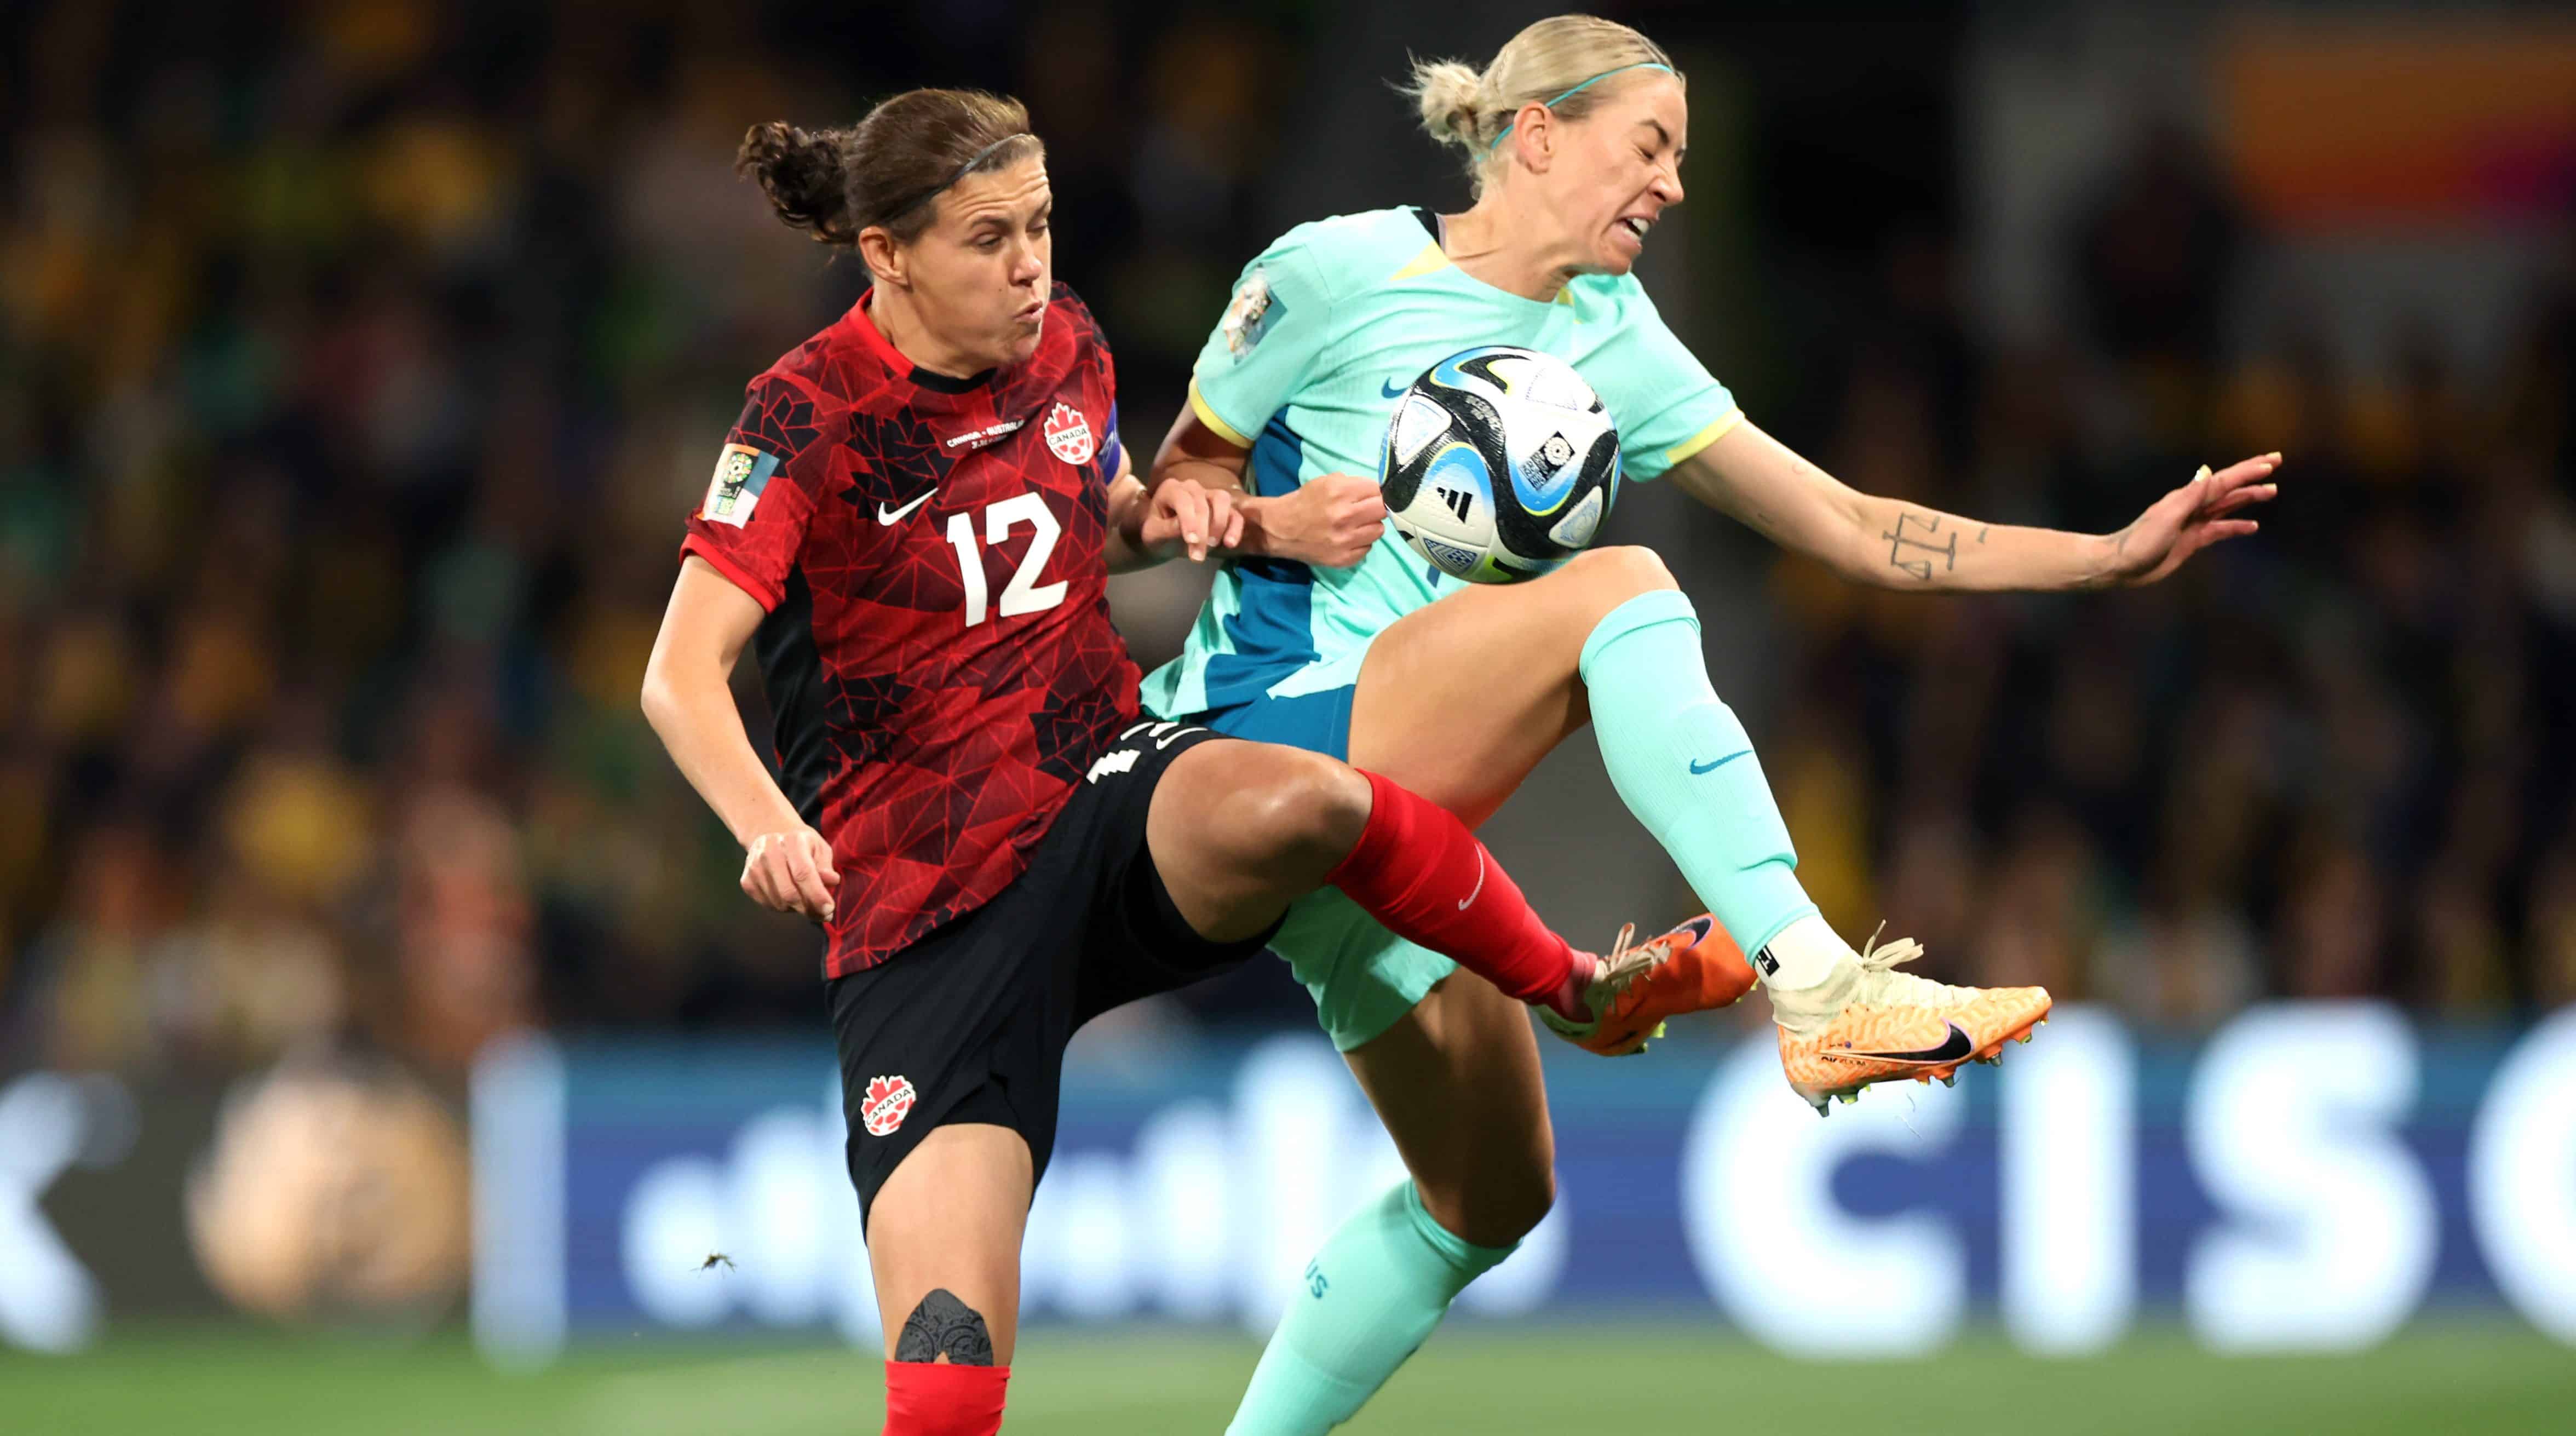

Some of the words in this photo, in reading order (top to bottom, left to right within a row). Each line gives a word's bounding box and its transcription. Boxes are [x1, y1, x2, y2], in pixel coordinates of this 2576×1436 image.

[1049, 428, 1087, 445] CANADA
[947, 492, 1068, 627] 12
[866, 1089, 911, 1125] CANADA
